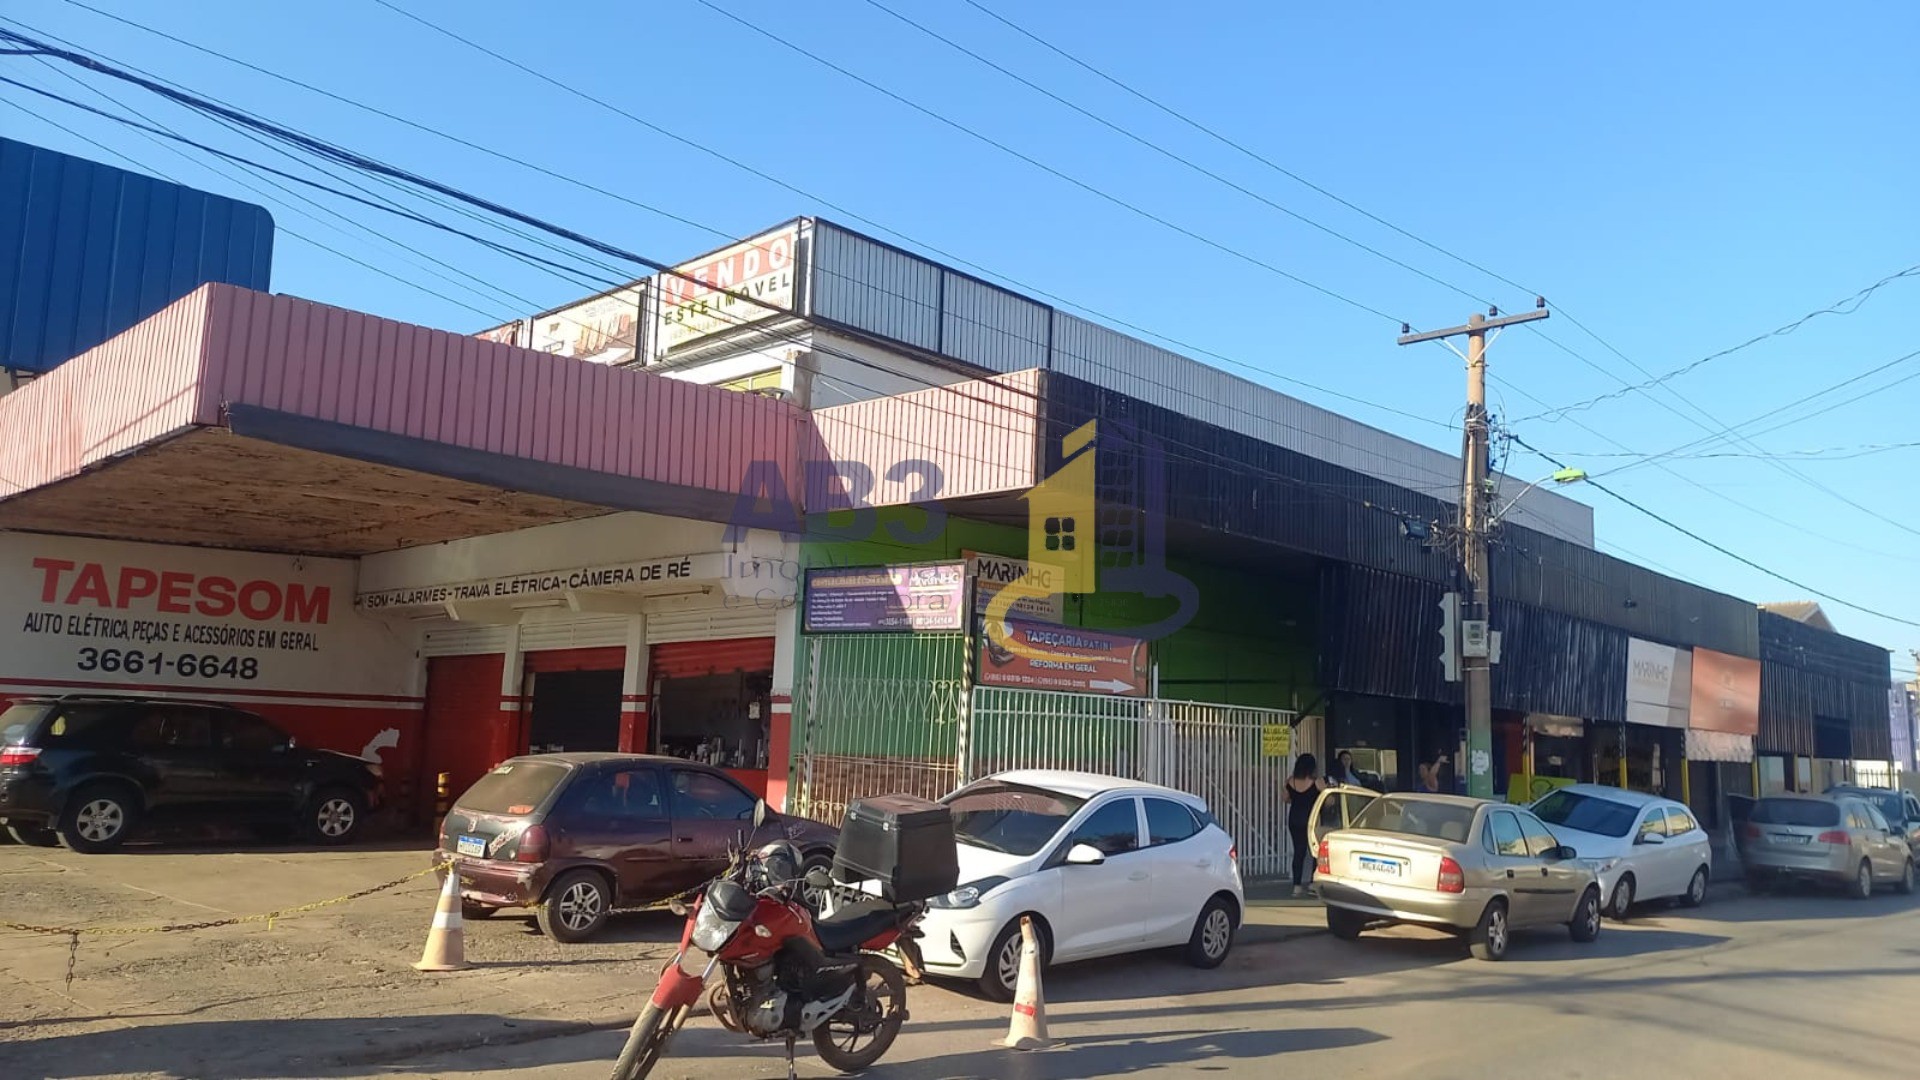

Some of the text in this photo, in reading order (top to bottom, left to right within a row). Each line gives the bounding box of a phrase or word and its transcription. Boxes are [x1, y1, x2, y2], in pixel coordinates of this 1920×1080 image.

[667, 237, 788, 306] VENDO
[664, 300, 708, 326] ESTE
[640, 564, 662, 580] DE
[667, 557, 692, 578] RÉ
[33, 557, 331, 625] TAPESOM
[23, 612, 62, 635] AUTO
[172, 623, 180, 642] E
[184, 624, 255, 648] ACESSÓRIOS
[257, 630, 276, 649] EM
[280, 632, 319, 651] GERAL
[1025, 629, 1083, 649] TAPEÇARIA
[77, 647, 259, 680] 3661-6648
[1030, 659, 1097, 673] REFORMA EM GERAL
